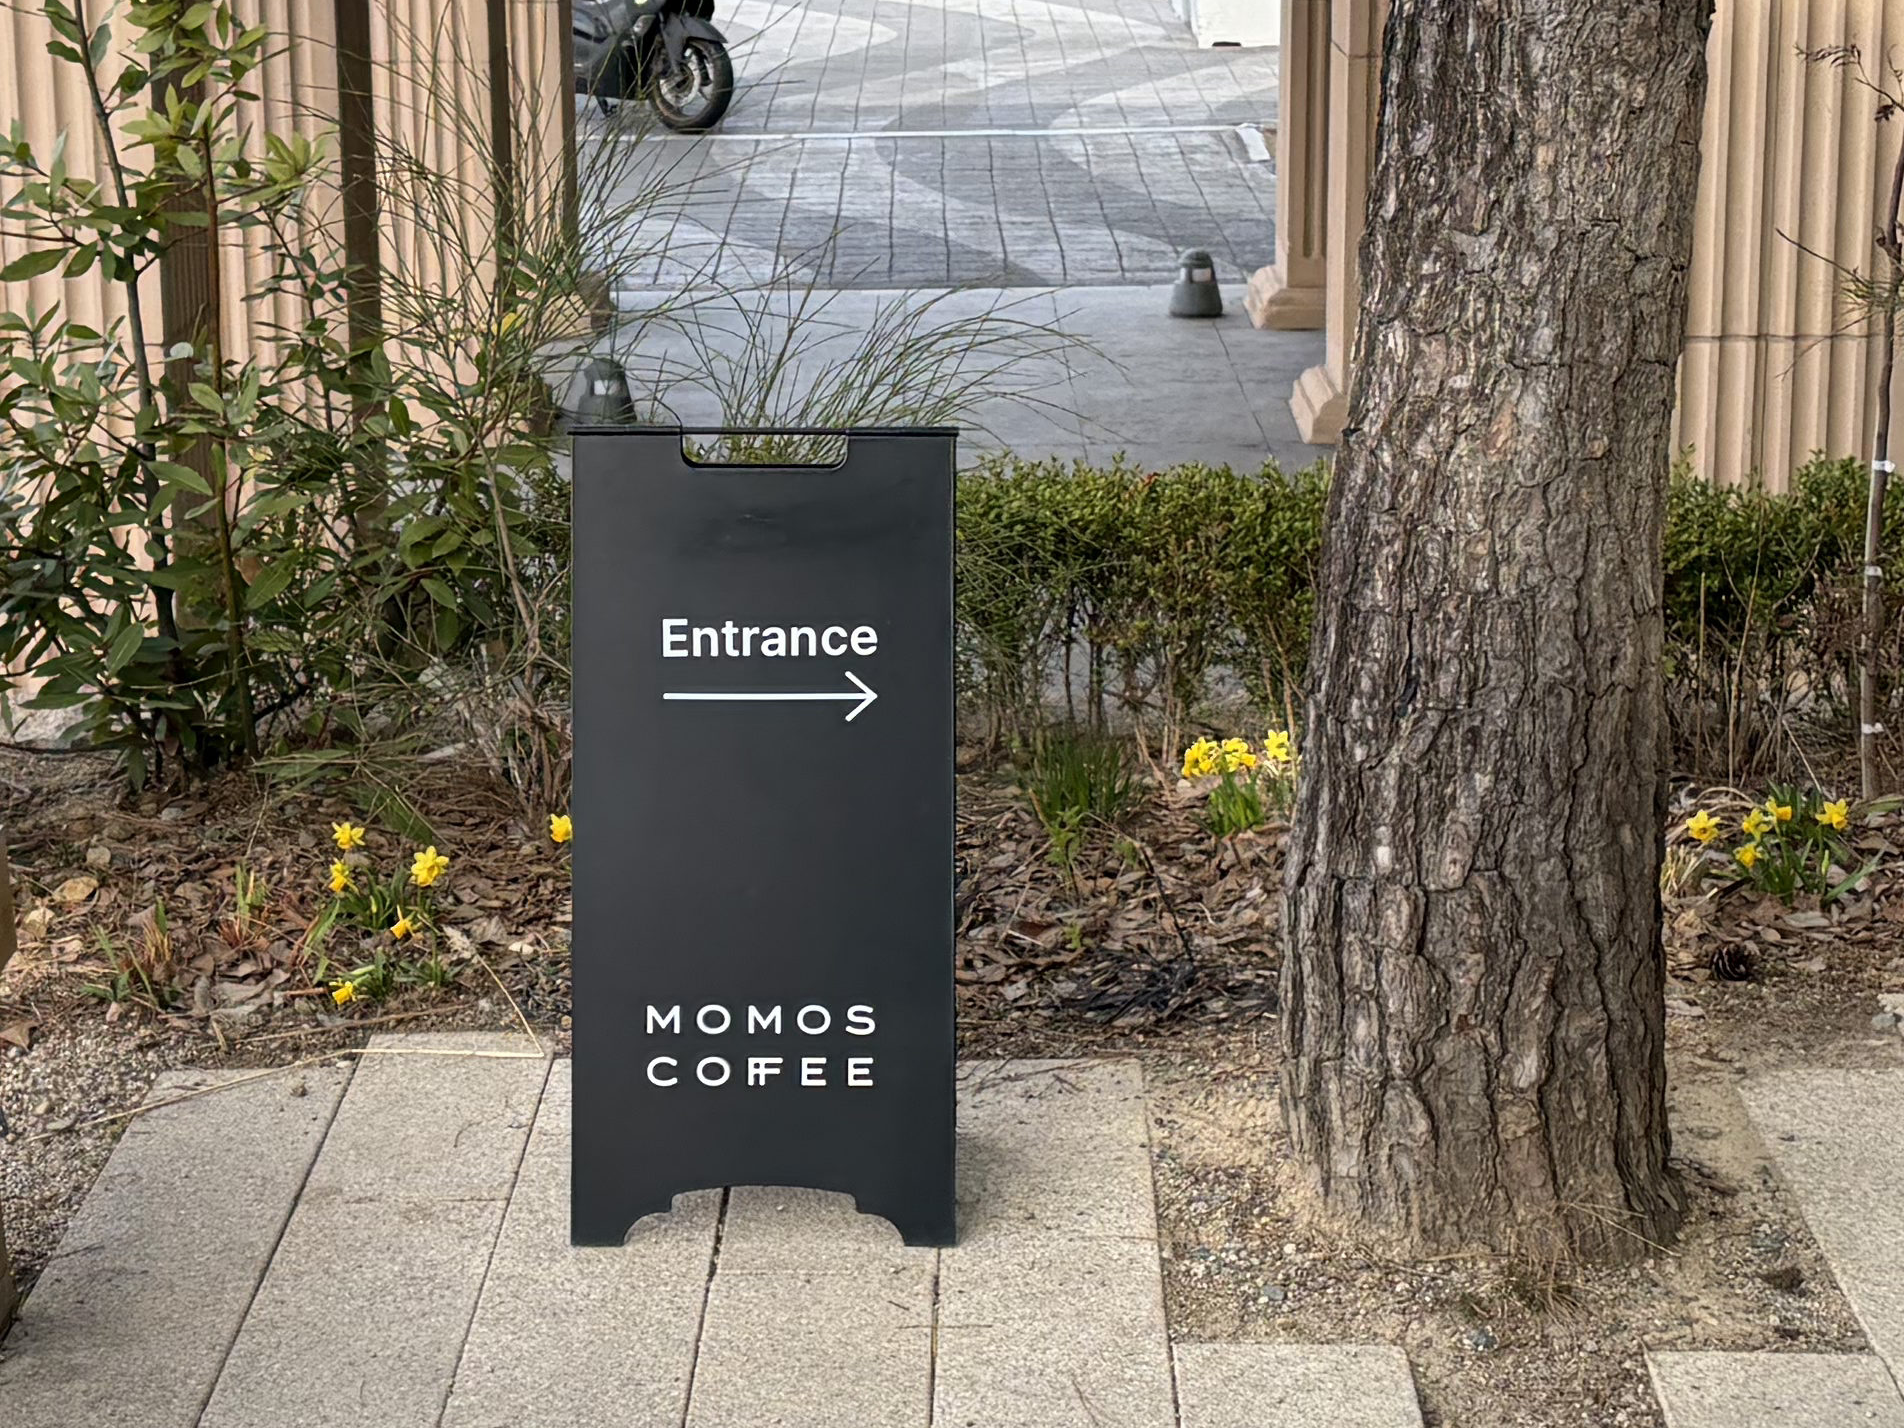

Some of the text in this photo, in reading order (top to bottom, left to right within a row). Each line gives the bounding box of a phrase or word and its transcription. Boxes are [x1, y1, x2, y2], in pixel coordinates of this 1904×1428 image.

[661, 617, 880, 659] Entrance
[645, 1003, 877, 1037] MOMOS
[645, 1054, 875, 1088] COFFEE
